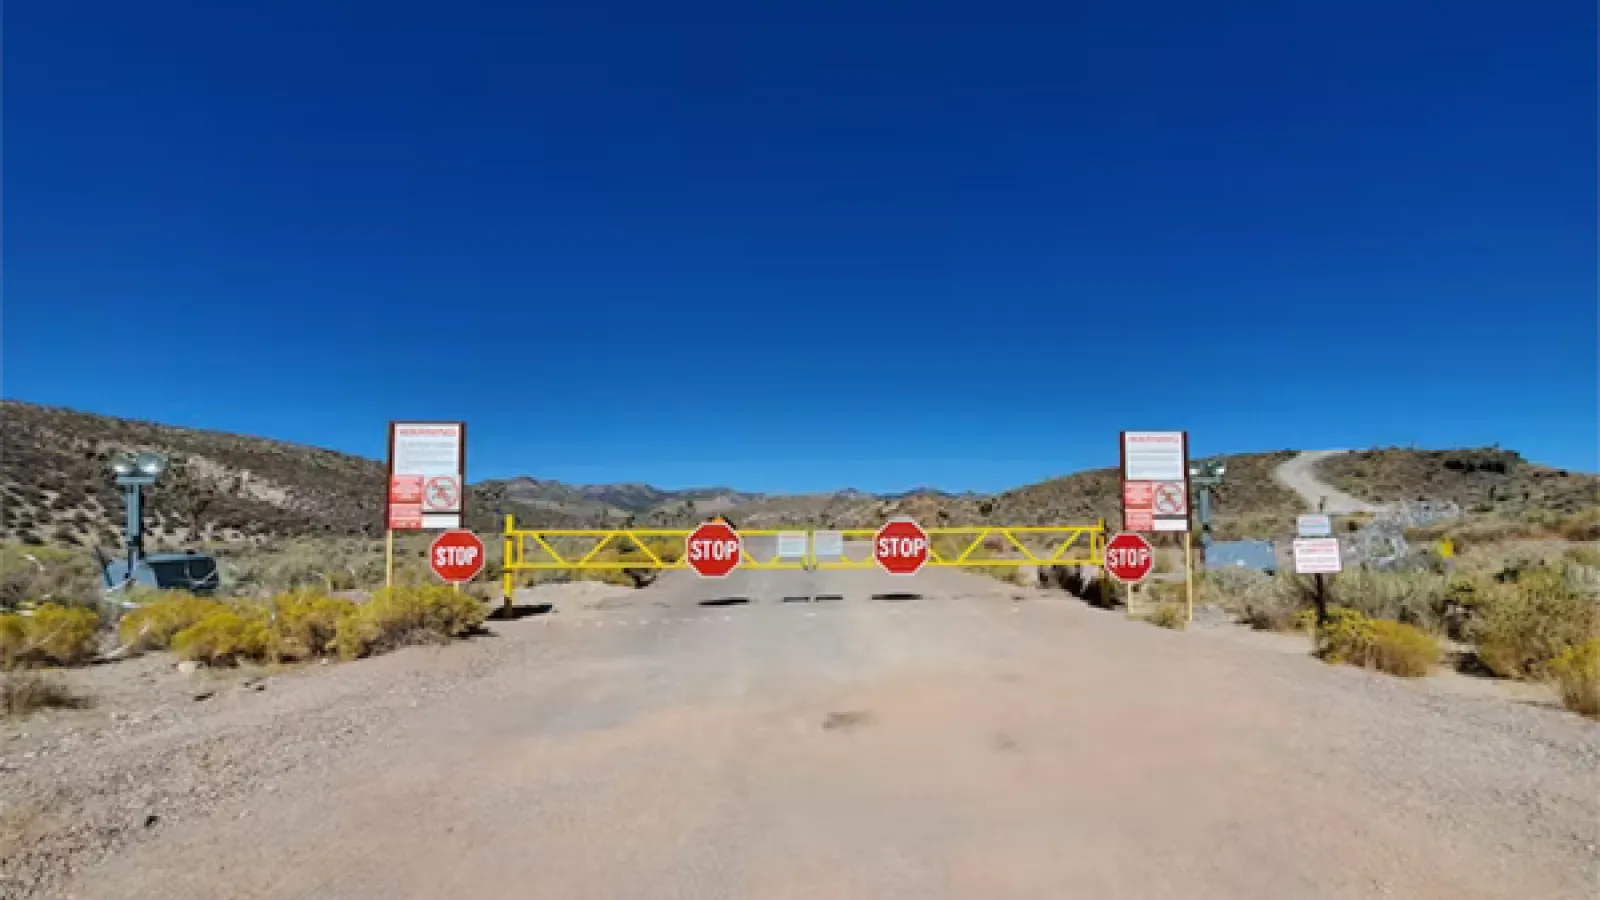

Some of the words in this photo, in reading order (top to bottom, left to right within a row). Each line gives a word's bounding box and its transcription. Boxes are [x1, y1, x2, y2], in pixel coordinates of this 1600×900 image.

[436, 545, 478, 566] STOP
[690, 540, 738, 560] STOP
[879, 538, 928, 558] STOP
[1108, 548, 1151, 567] STOP
